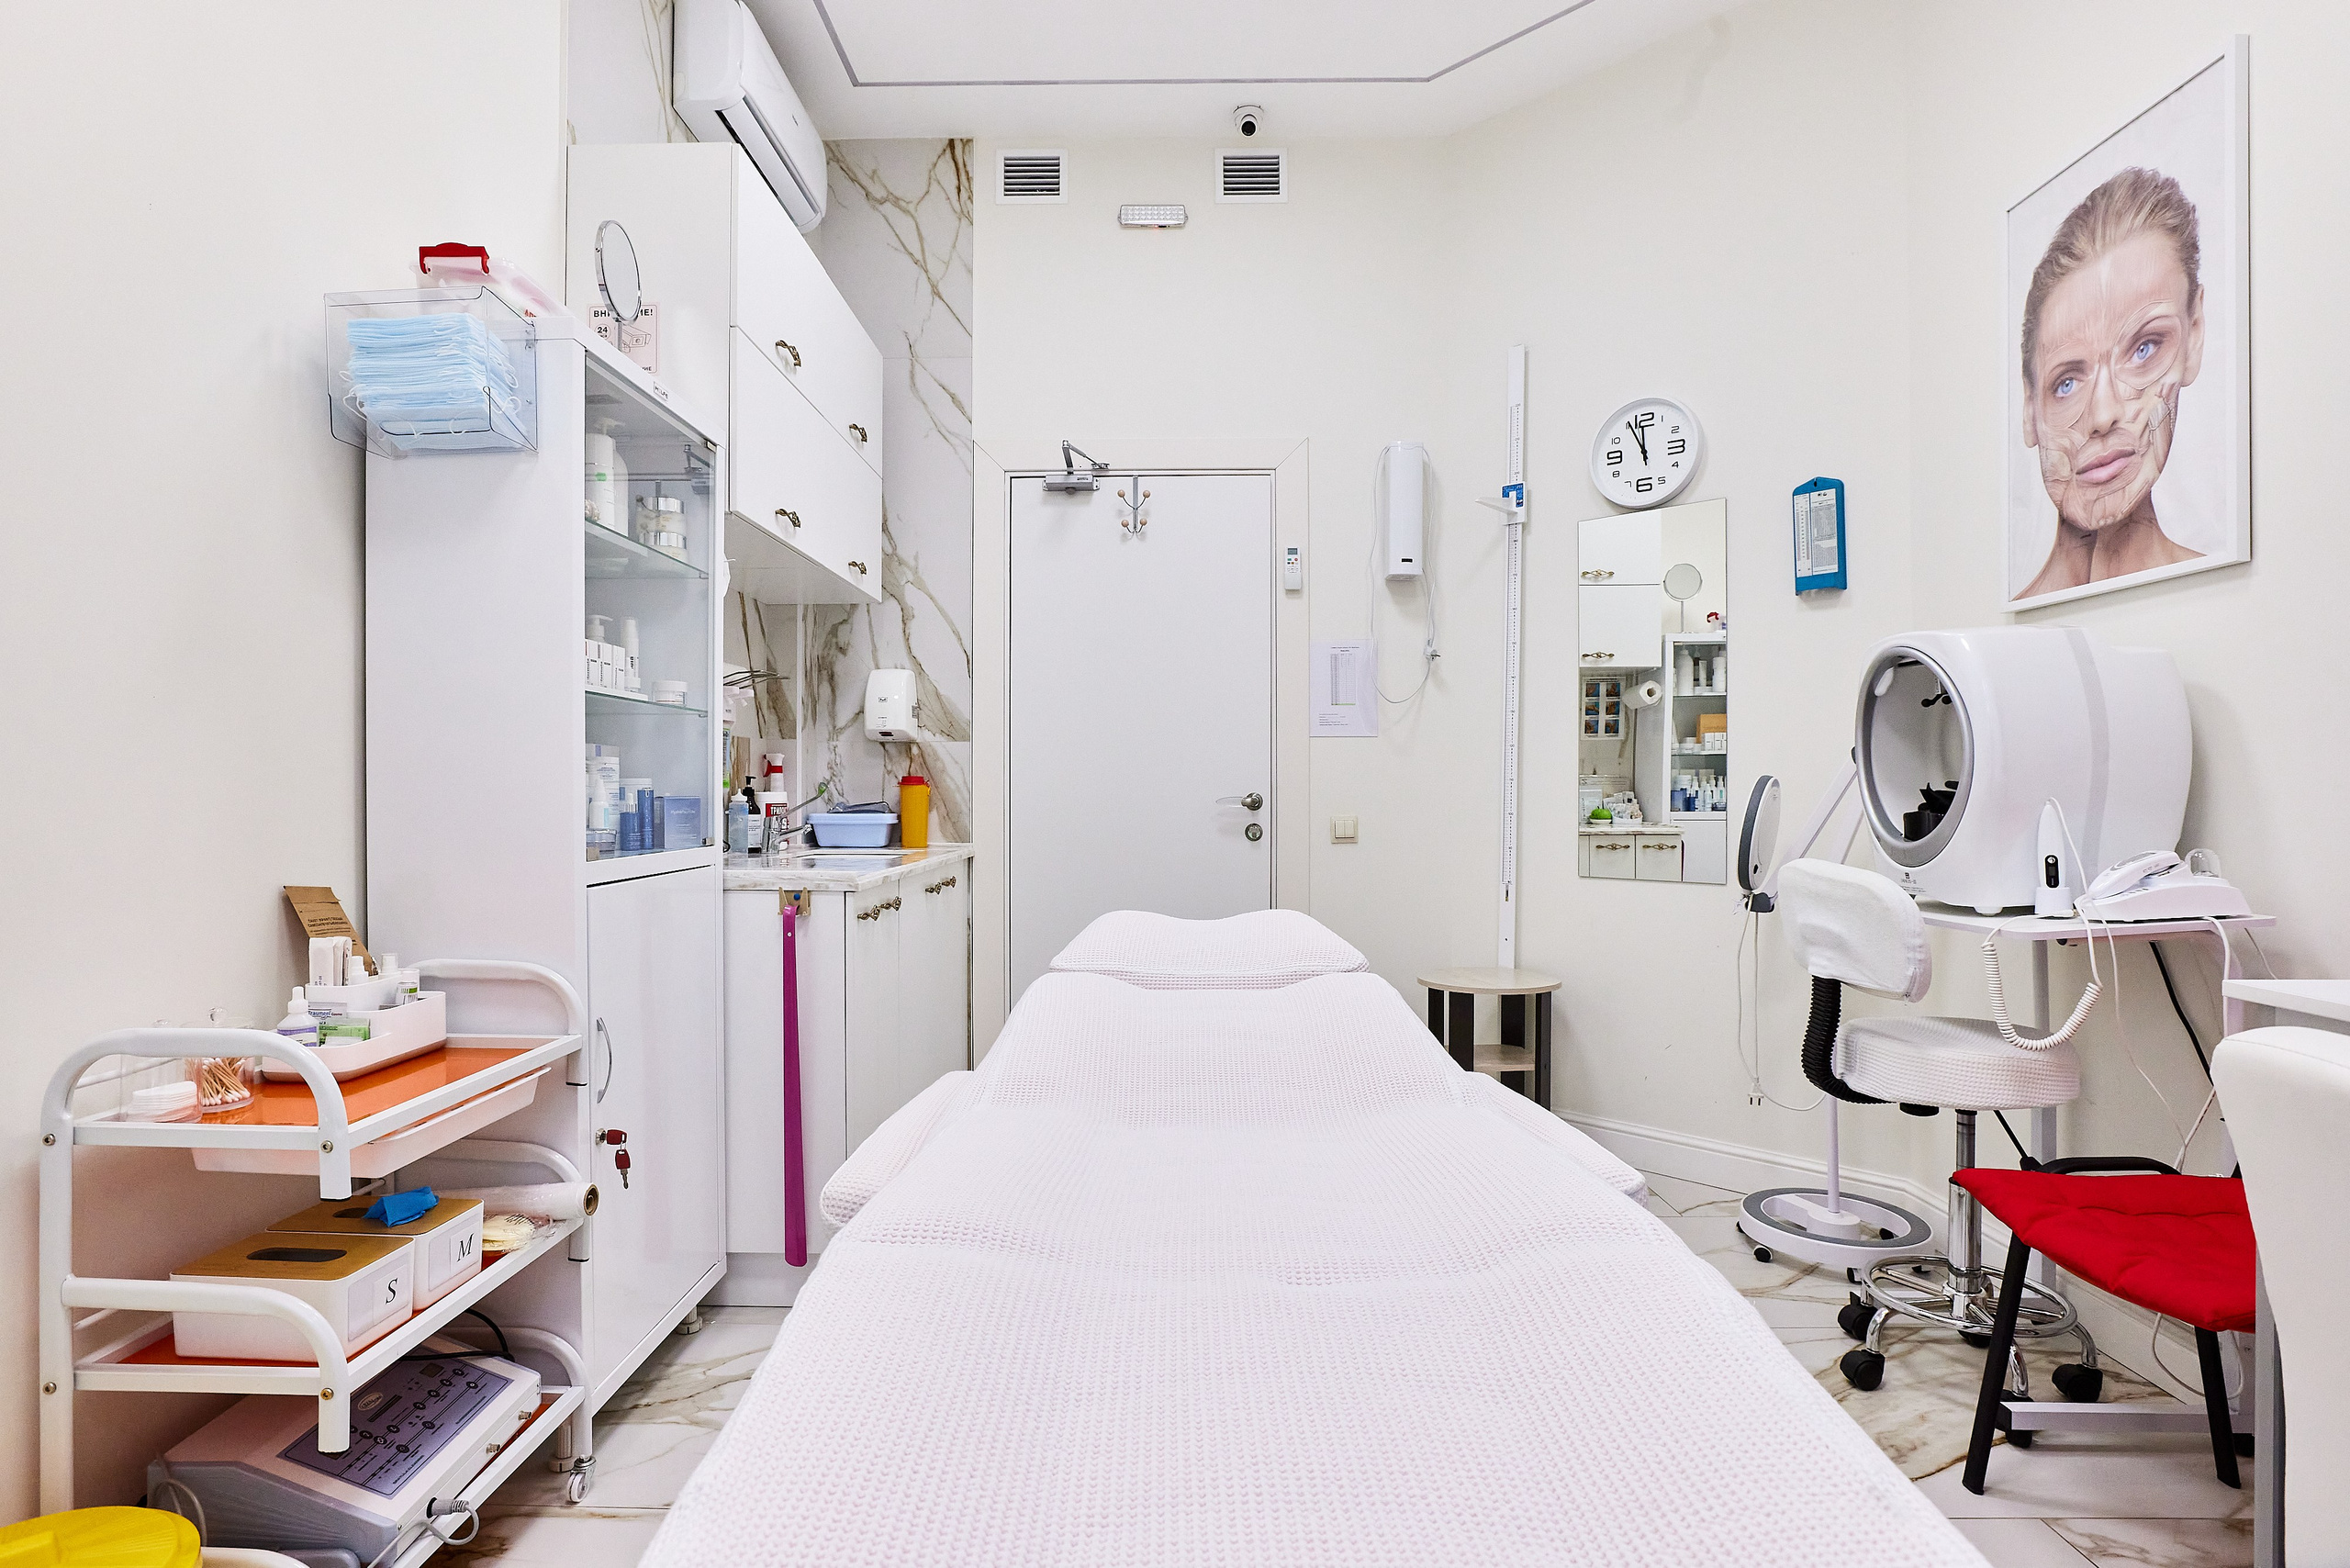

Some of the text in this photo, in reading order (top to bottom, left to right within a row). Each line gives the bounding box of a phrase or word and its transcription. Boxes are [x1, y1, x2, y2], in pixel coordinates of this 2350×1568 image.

[1635, 412, 1654, 430] 12
[1671, 425, 1680, 433] 2
[1611, 437, 1620, 445] 10
[1667, 438, 1685, 455] 3
[1606, 450, 1623, 466] 9
[1636, 476, 1652, 493] 6
[1657, 476, 1666, 485] 5
[456, 1232, 475, 1262] M
[385, 1277, 398, 1305] S
